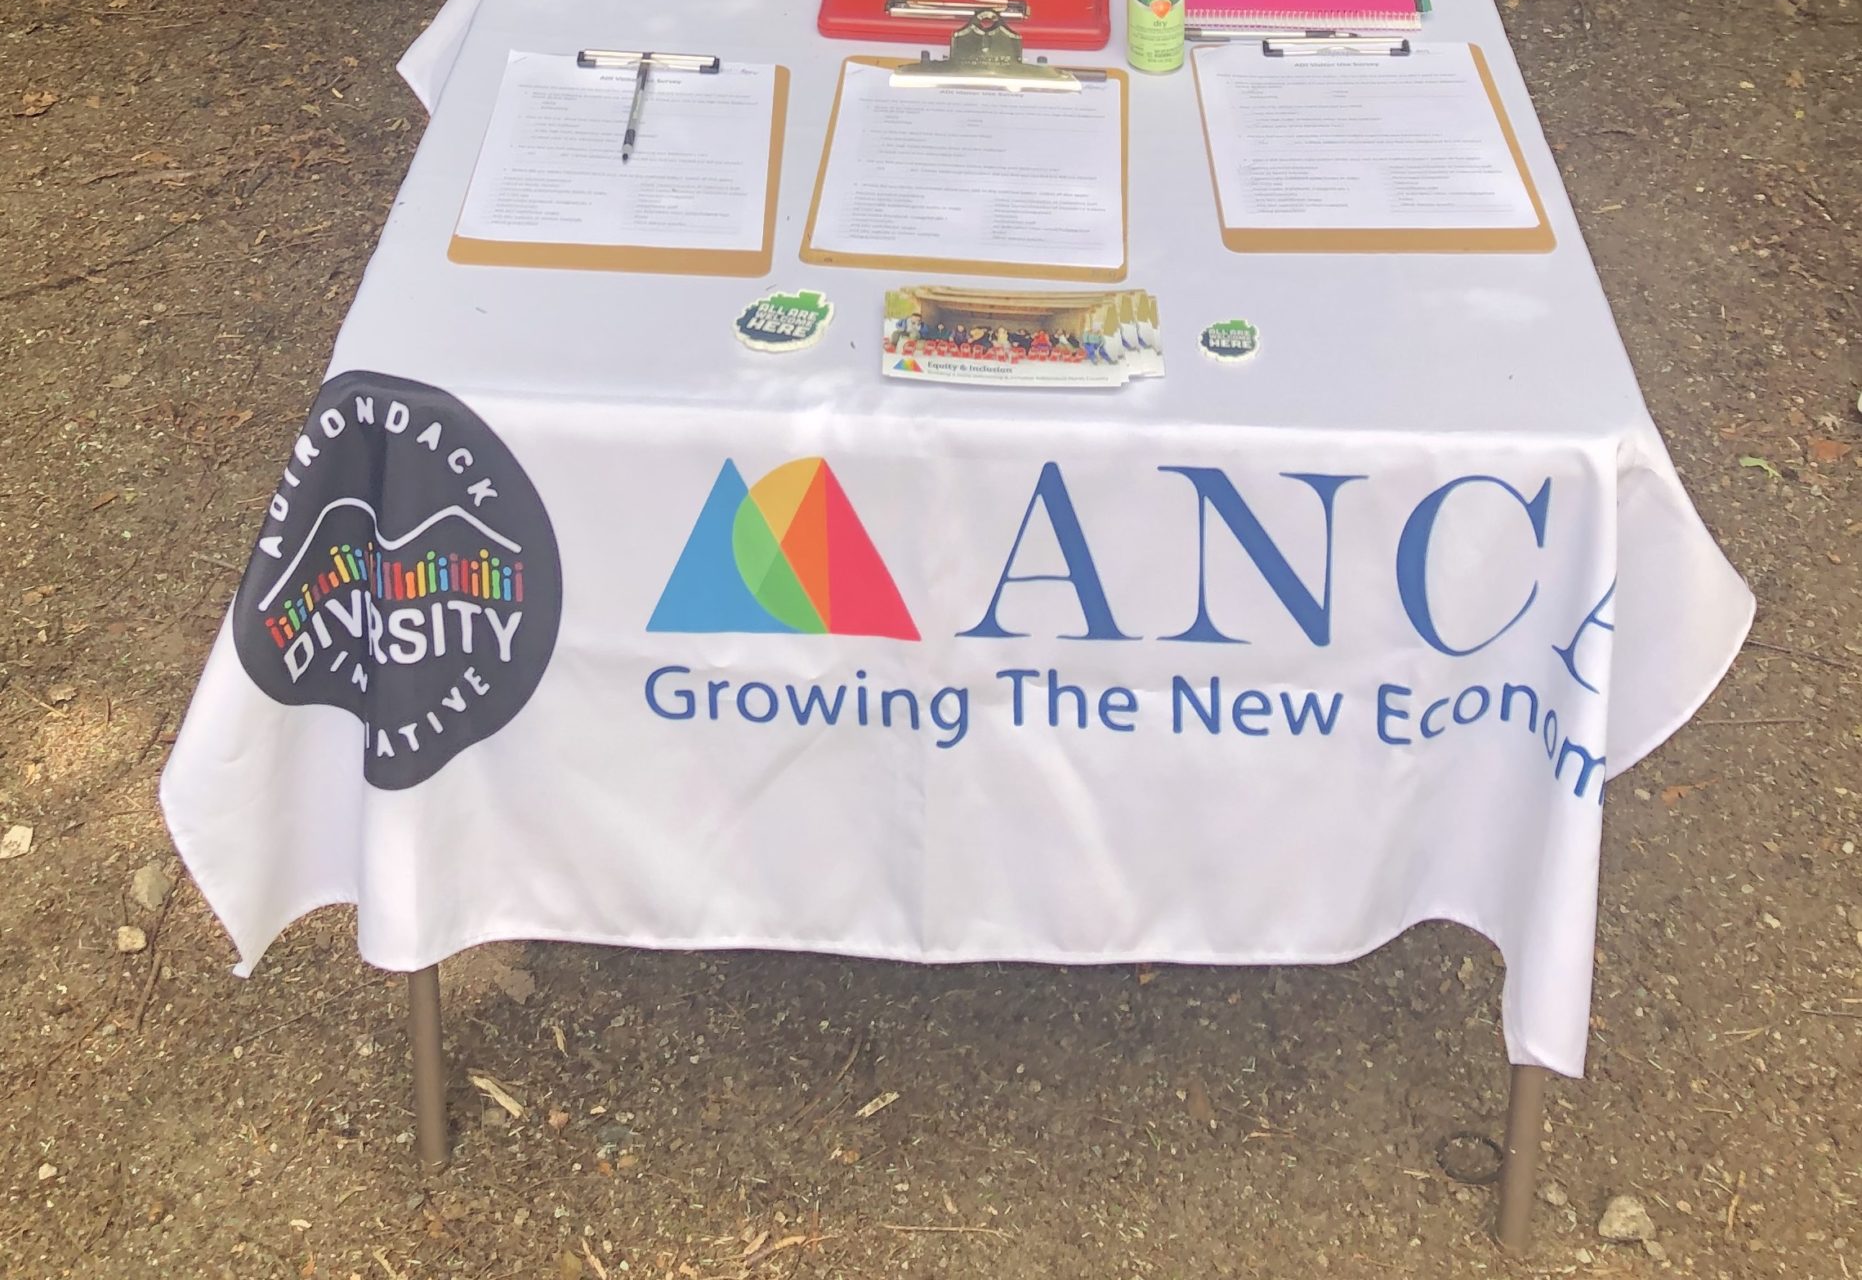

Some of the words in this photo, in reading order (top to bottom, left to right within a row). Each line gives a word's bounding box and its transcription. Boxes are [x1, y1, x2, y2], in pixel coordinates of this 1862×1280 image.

[746, 317, 809, 338] HERE
[758, 303, 785, 315] ALL
[787, 308, 819, 322] ARE
[927, 361, 957, 371] Equity
[969, 364, 1013, 373] Inclusion
[258, 396, 499, 559] ADIRONDACK
[283, 589, 523, 683] DIVRSITY
[643, 664, 972, 749] Growing
[995, 667, 1138, 733] The
[1171, 674, 1344, 738] New
